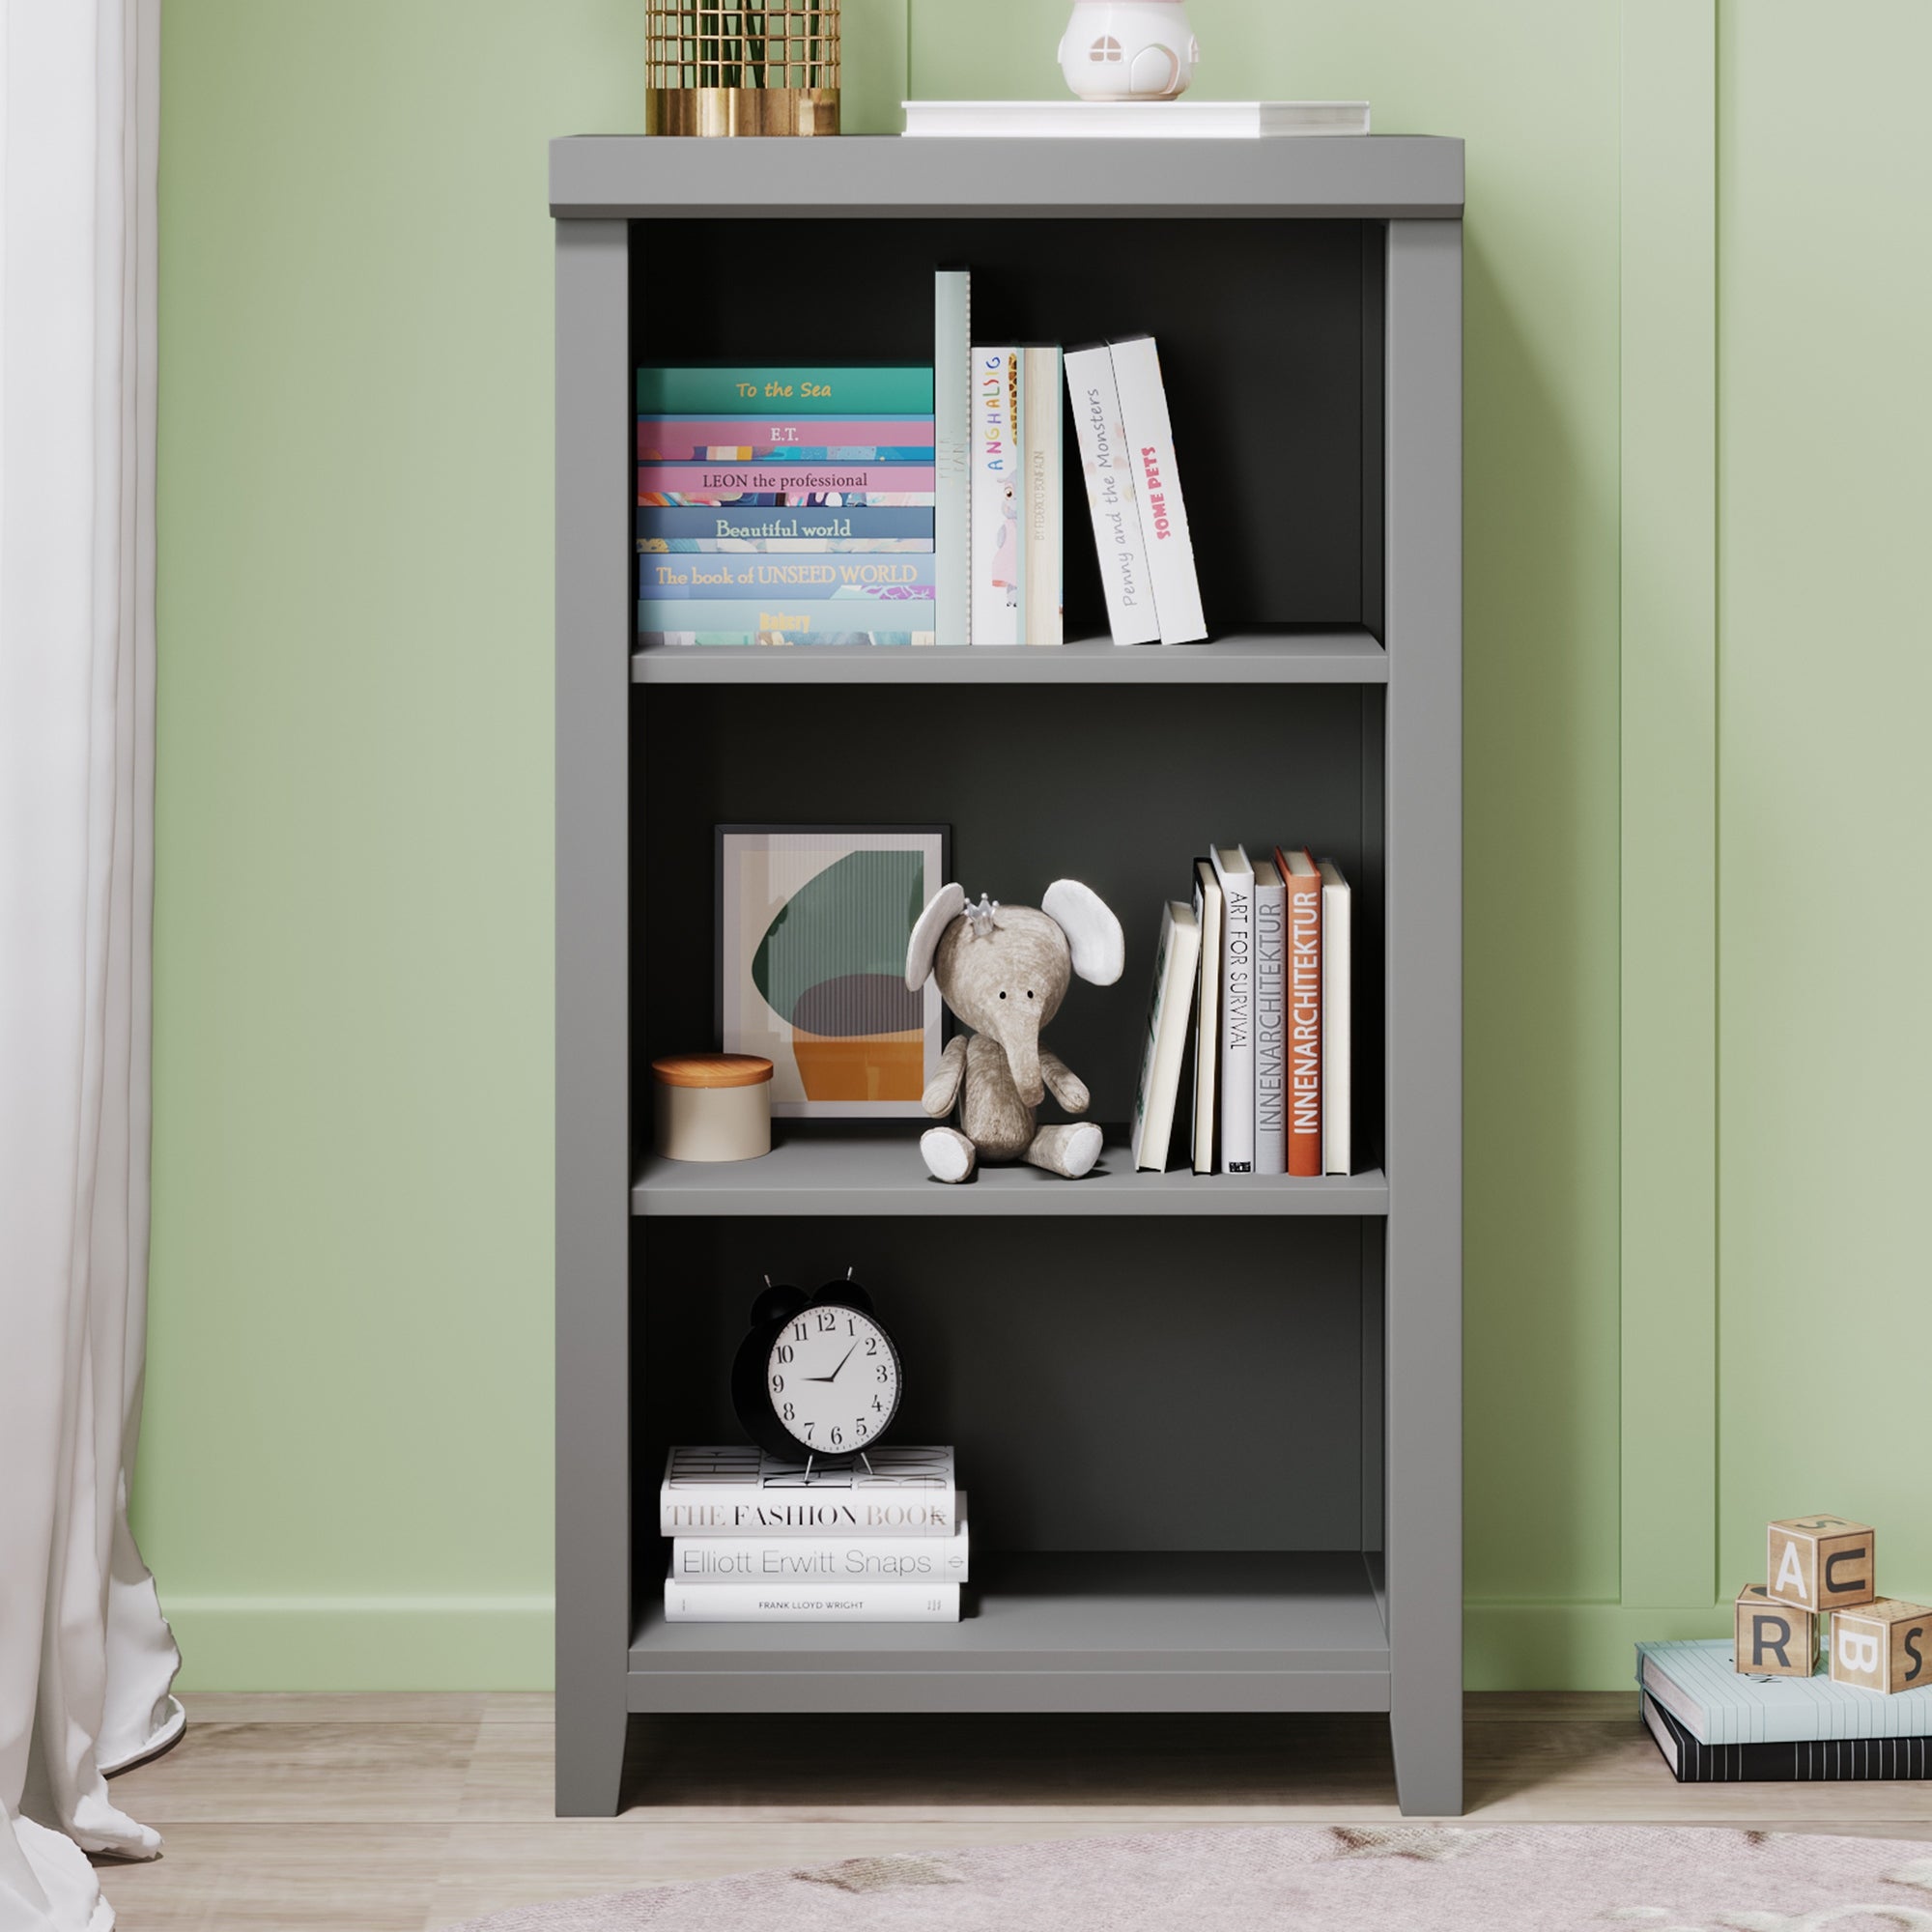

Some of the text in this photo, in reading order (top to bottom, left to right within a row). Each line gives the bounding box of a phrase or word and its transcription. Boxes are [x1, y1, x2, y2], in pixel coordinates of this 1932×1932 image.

[735, 382, 832, 397] To the Sea
[770, 427, 799, 441] E.T.
[702, 472, 868, 491] LEON the professional
[1088, 388, 1137, 607] Penny and the Monsters
[1141, 446, 1171, 540] SOME PETS
[716, 519, 852, 538] Beautiful world
[656, 565, 918, 584] The book of UNSEED WORLD
[1230, 891, 1248, 1050] ART FOR SURVIVAL
[1260, 902, 1282, 1133] INNENARCHITEKTUR
[1293, 892, 1318, 1134] INNENARCHITEKTUR
[794, 1322, 809, 1341] 11
[816, 1313, 836, 1332] 12
[847, 1319, 855, 1336] 1
[776, 1345, 794, 1364] 10
[866, 1338, 877, 1355] 2
[876, 1365, 888, 1382] 3
[773, 1375, 784, 1393] 9
[783, 1403, 795, 1420] 8
[871, 1395, 883, 1412] 4
[804, 1422, 815, 1440] 7
[831, 1427, 842, 1445] 6
[856, 1418, 867, 1435] 5
[667, 1505, 948, 1526] THE FASHION BOOK
[683, 1549, 932, 1577] Elliott Erwitt Snaps
[1776, 1541, 1807, 1599] A
[1752, 1614, 1792, 1667] R
[1838, 1629, 1878, 1673] B
[1904, 1627, 1923, 1682] S
